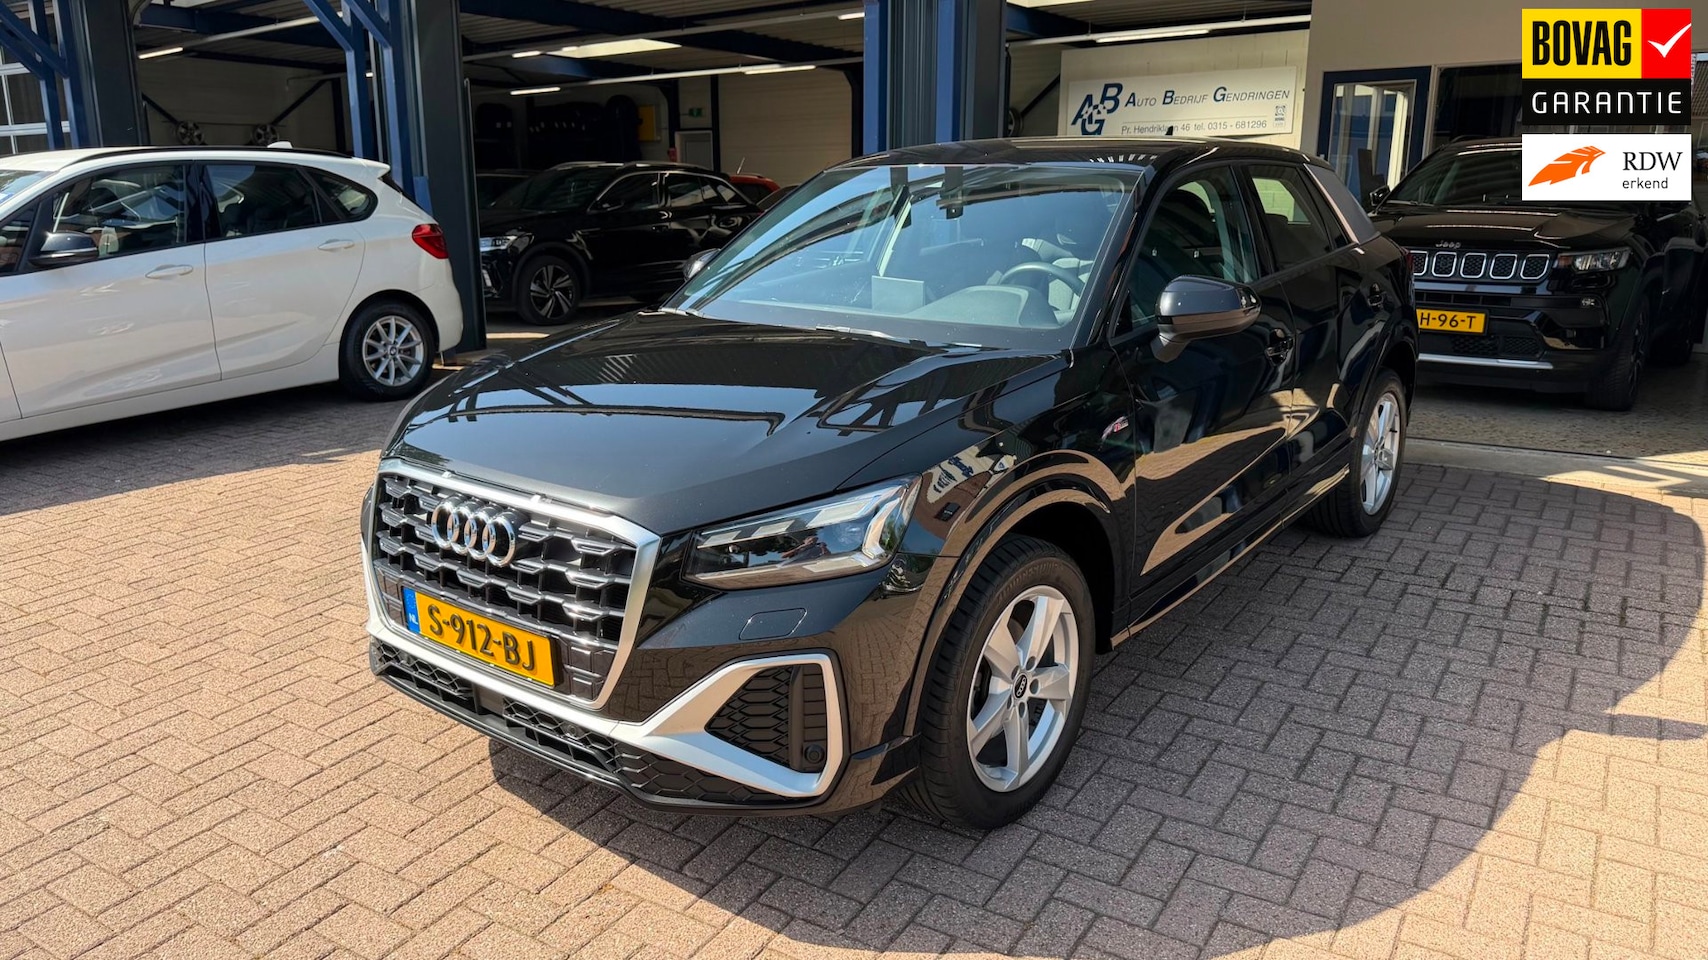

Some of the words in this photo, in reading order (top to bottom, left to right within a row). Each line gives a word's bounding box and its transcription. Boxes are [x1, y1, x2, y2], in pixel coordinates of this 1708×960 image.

[1180, 123, 1191, 132] 46
[1207, 121, 1228, 131] 0315
[1235, 119, 1268, 130] 681296
[1435, 240, 1461, 250] Jeep
[408, 612, 419, 625] NL
[427, 603, 536, 672] S-912-BJ
